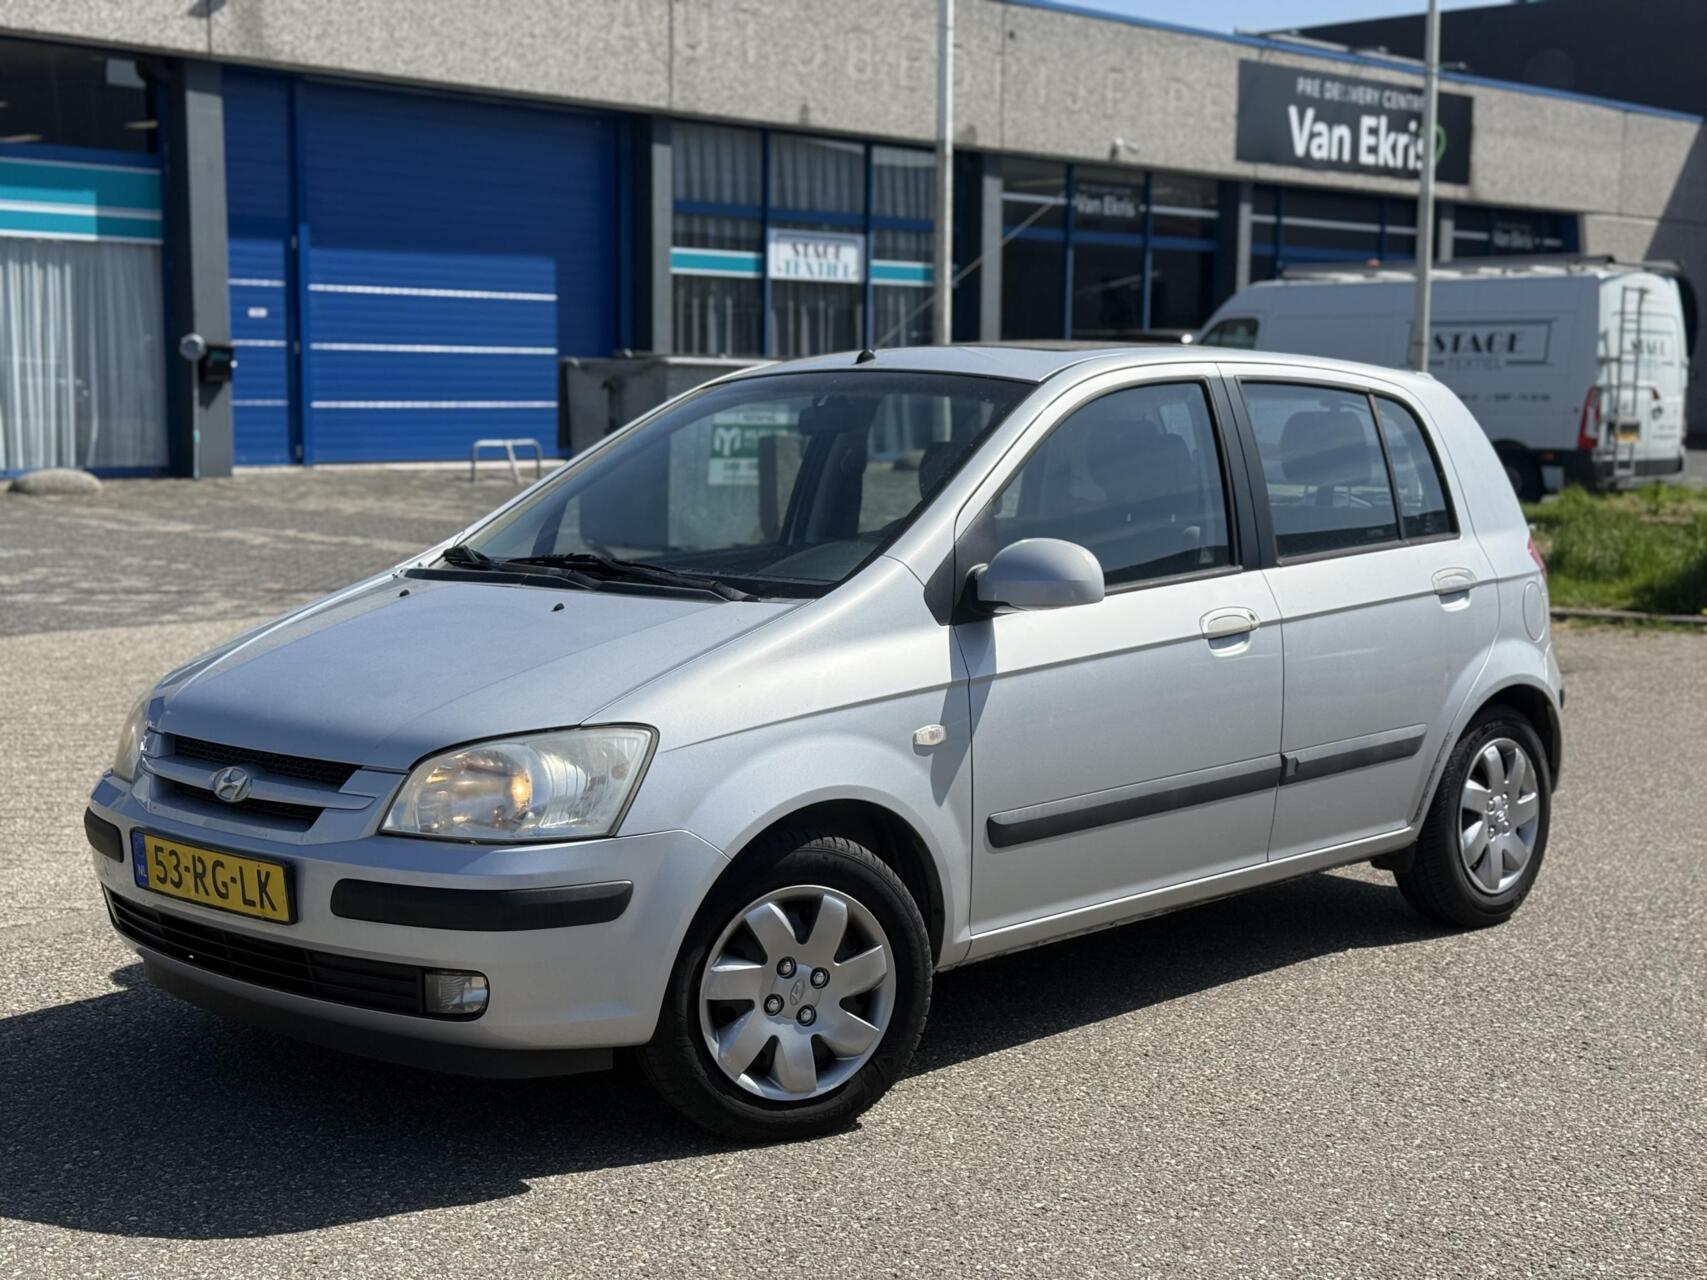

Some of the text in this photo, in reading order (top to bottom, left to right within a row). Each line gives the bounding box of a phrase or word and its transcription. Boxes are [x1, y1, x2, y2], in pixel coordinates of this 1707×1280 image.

[1296, 76, 1320, 98] PRE
[1323, 80, 1380, 106] DELIVERY
[1288, 104, 1351, 163] Van
[1431, 329, 1528, 354] STAGE
[137, 863, 148, 877] NL
[154, 844, 278, 912] 53-RG-LK
